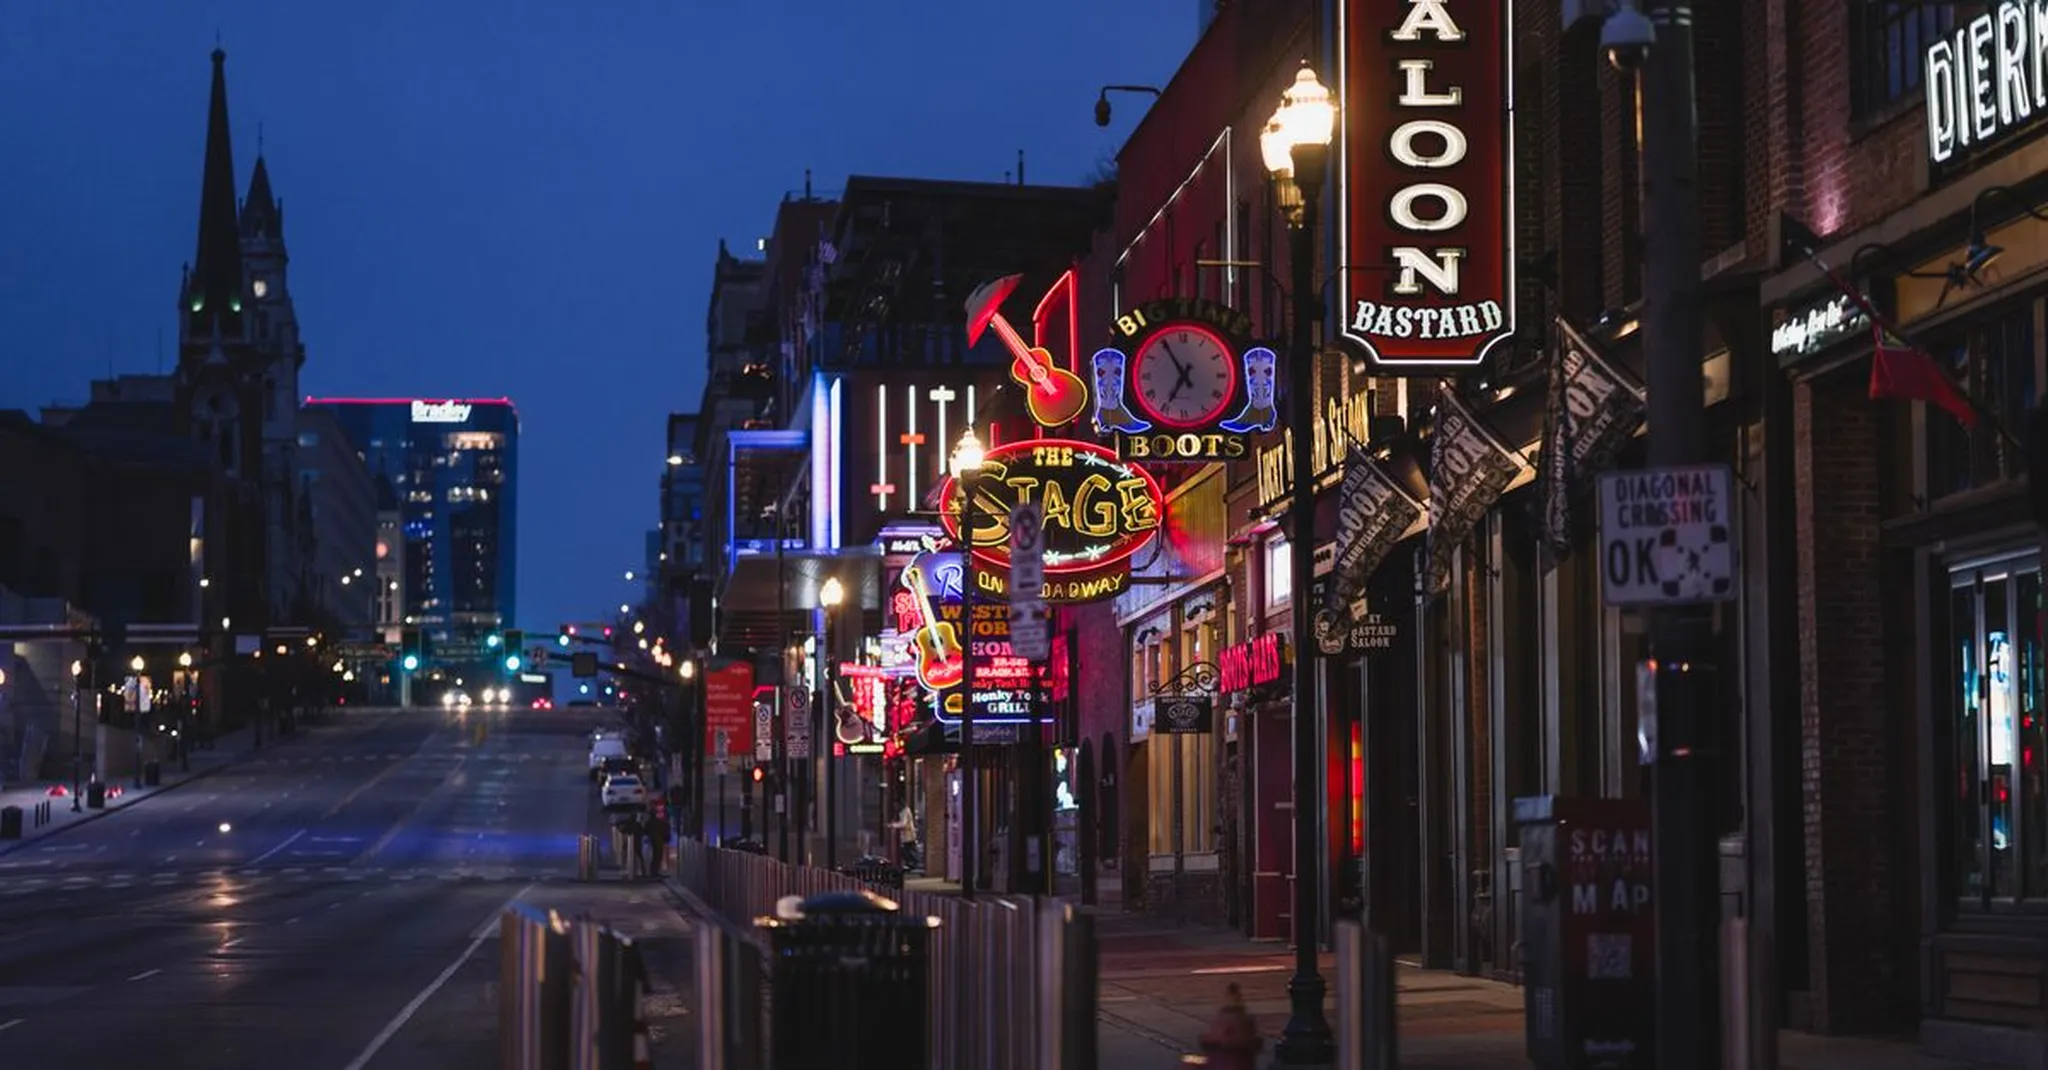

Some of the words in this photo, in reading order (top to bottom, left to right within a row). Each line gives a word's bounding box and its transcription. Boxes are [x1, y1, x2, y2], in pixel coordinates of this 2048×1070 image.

[1117, 303, 1166, 338] BIG
[1352, 300, 1504, 340] BASTARD
[412, 399, 472, 423] Bradley
[1033, 447, 1073, 467] THE
[1128, 433, 1244, 458] BOOTS
[1614, 473, 1717, 503] DIAGONAL
[958, 461, 1157, 546] STAGE
[1617, 499, 1717, 529] CROSSING
[1607, 537, 1661, 588] OK
[978, 571, 1004, 594] ON
[1038, 573, 1124, 598] OADWAY
[1016, 690, 1048, 703] Tok
[1570, 829, 1650, 855] SCAN
